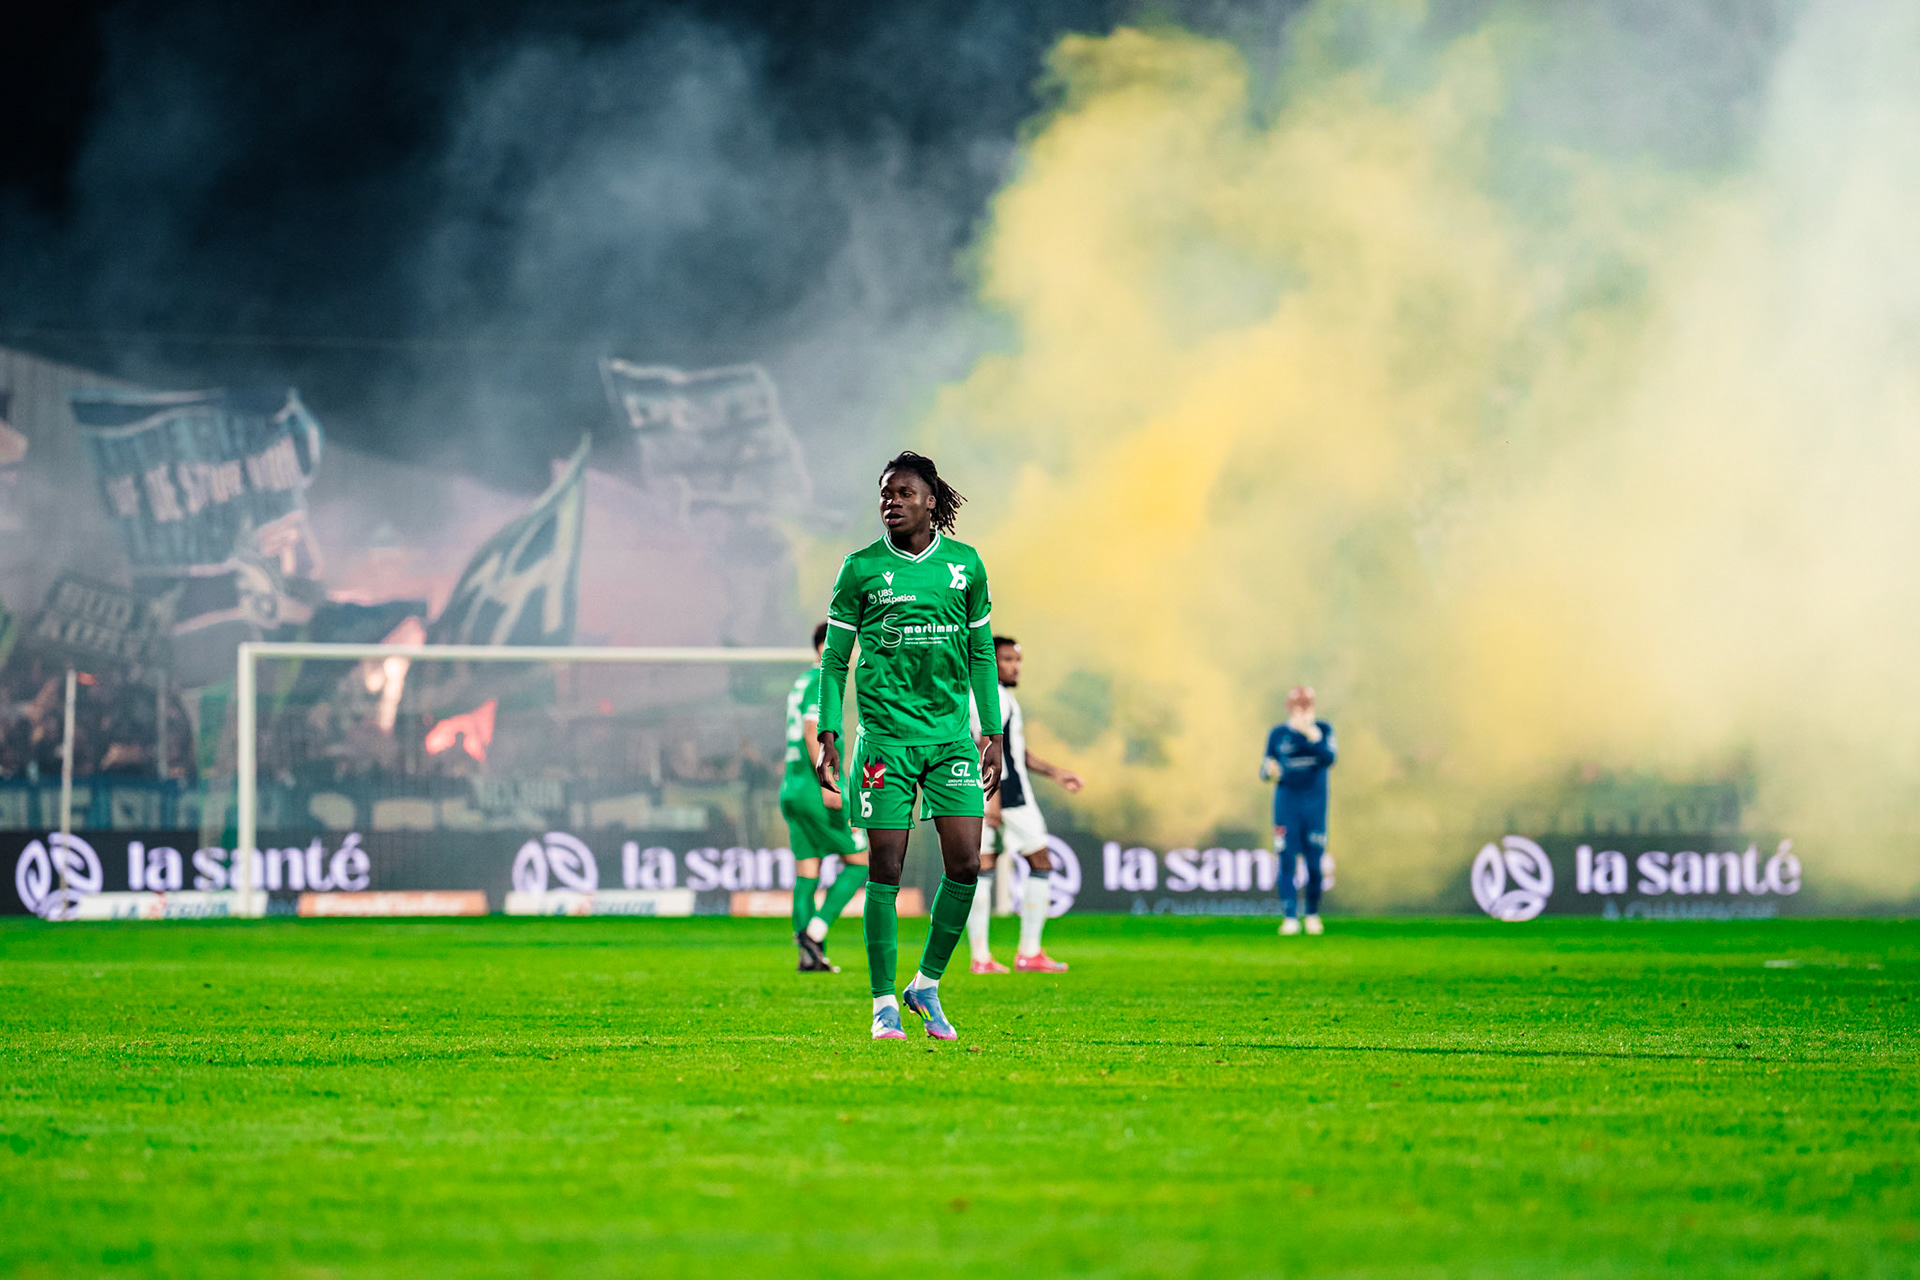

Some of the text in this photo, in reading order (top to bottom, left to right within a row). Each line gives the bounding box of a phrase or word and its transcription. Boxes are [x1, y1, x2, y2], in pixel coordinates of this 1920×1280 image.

[877, 587, 895, 597] UBS
[951, 762, 970, 776] GL
[127, 832, 371, 892] la santé
[621, 841, 843, 891] la san
[1102, 841, 1334, 892] la san
[1576, 839, 1802, 896] la santé
